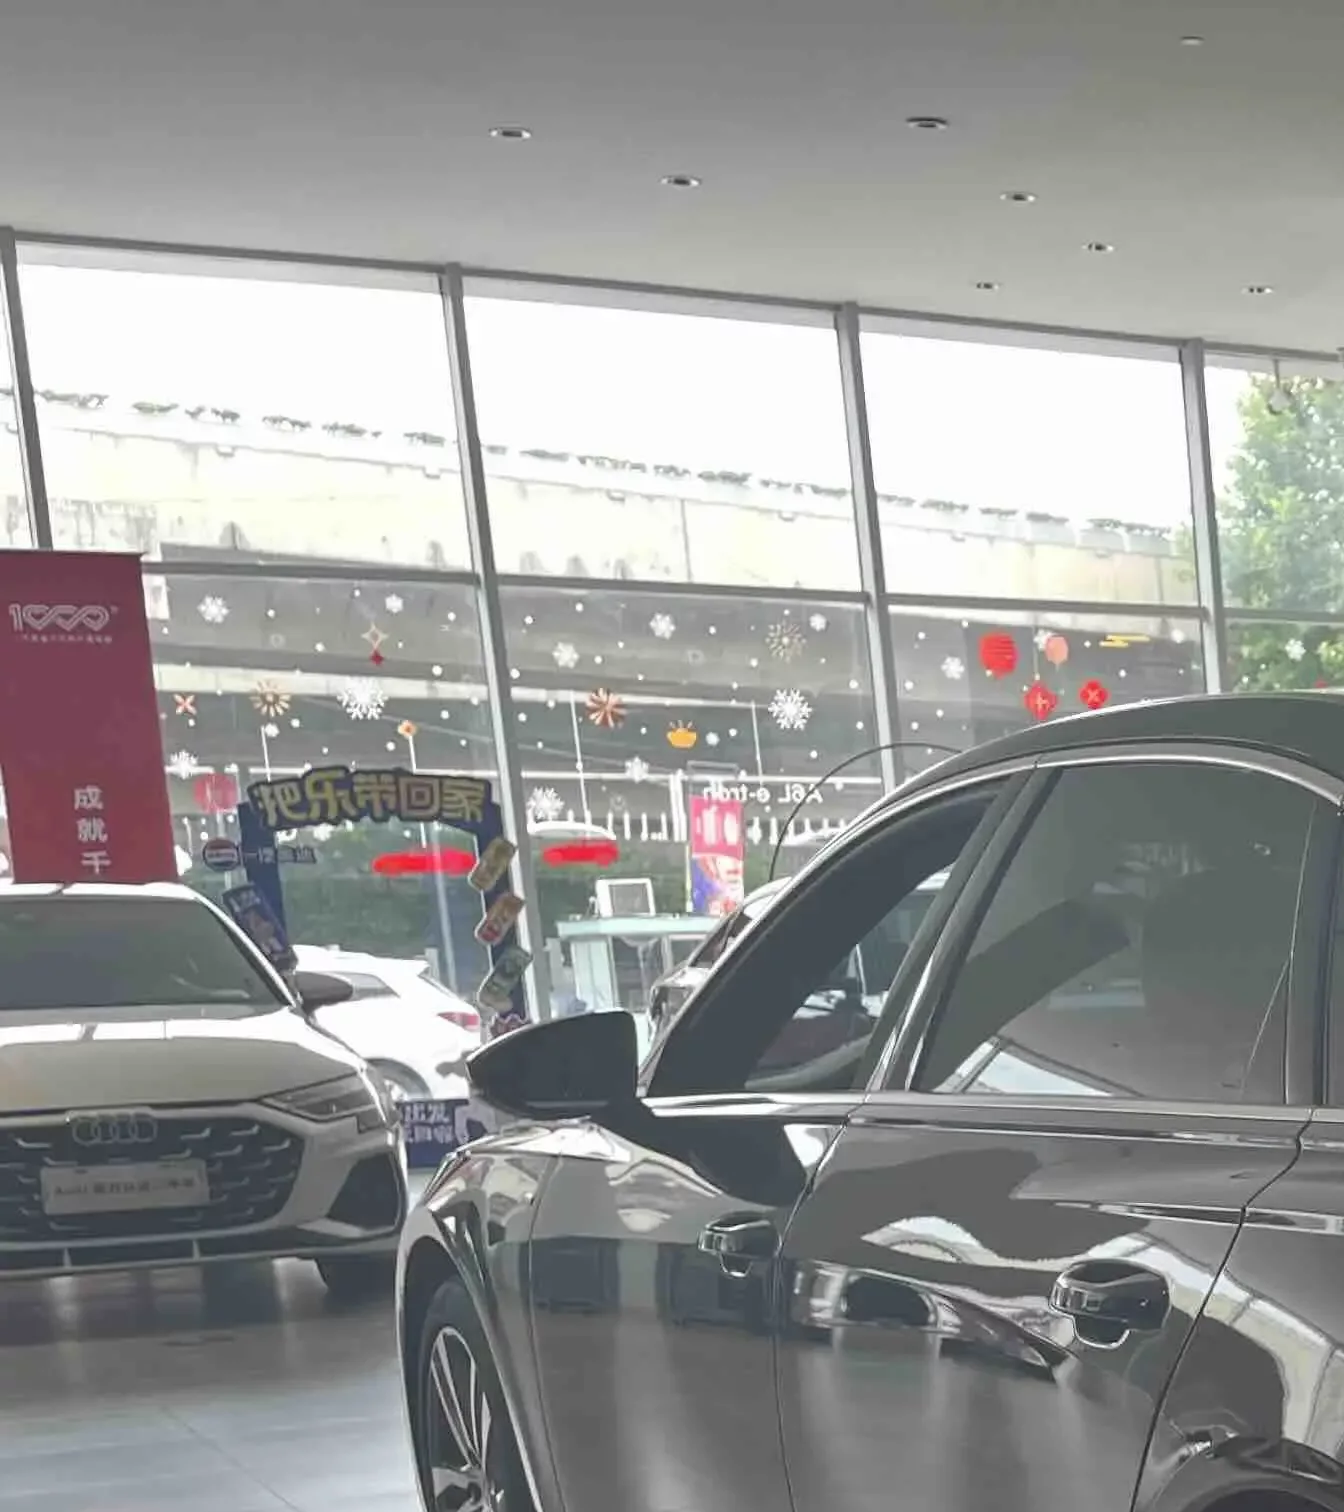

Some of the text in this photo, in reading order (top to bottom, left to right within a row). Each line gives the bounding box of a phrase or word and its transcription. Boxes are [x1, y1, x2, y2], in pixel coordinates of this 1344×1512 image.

[255, 770, 486, 827] 把乐带回家
